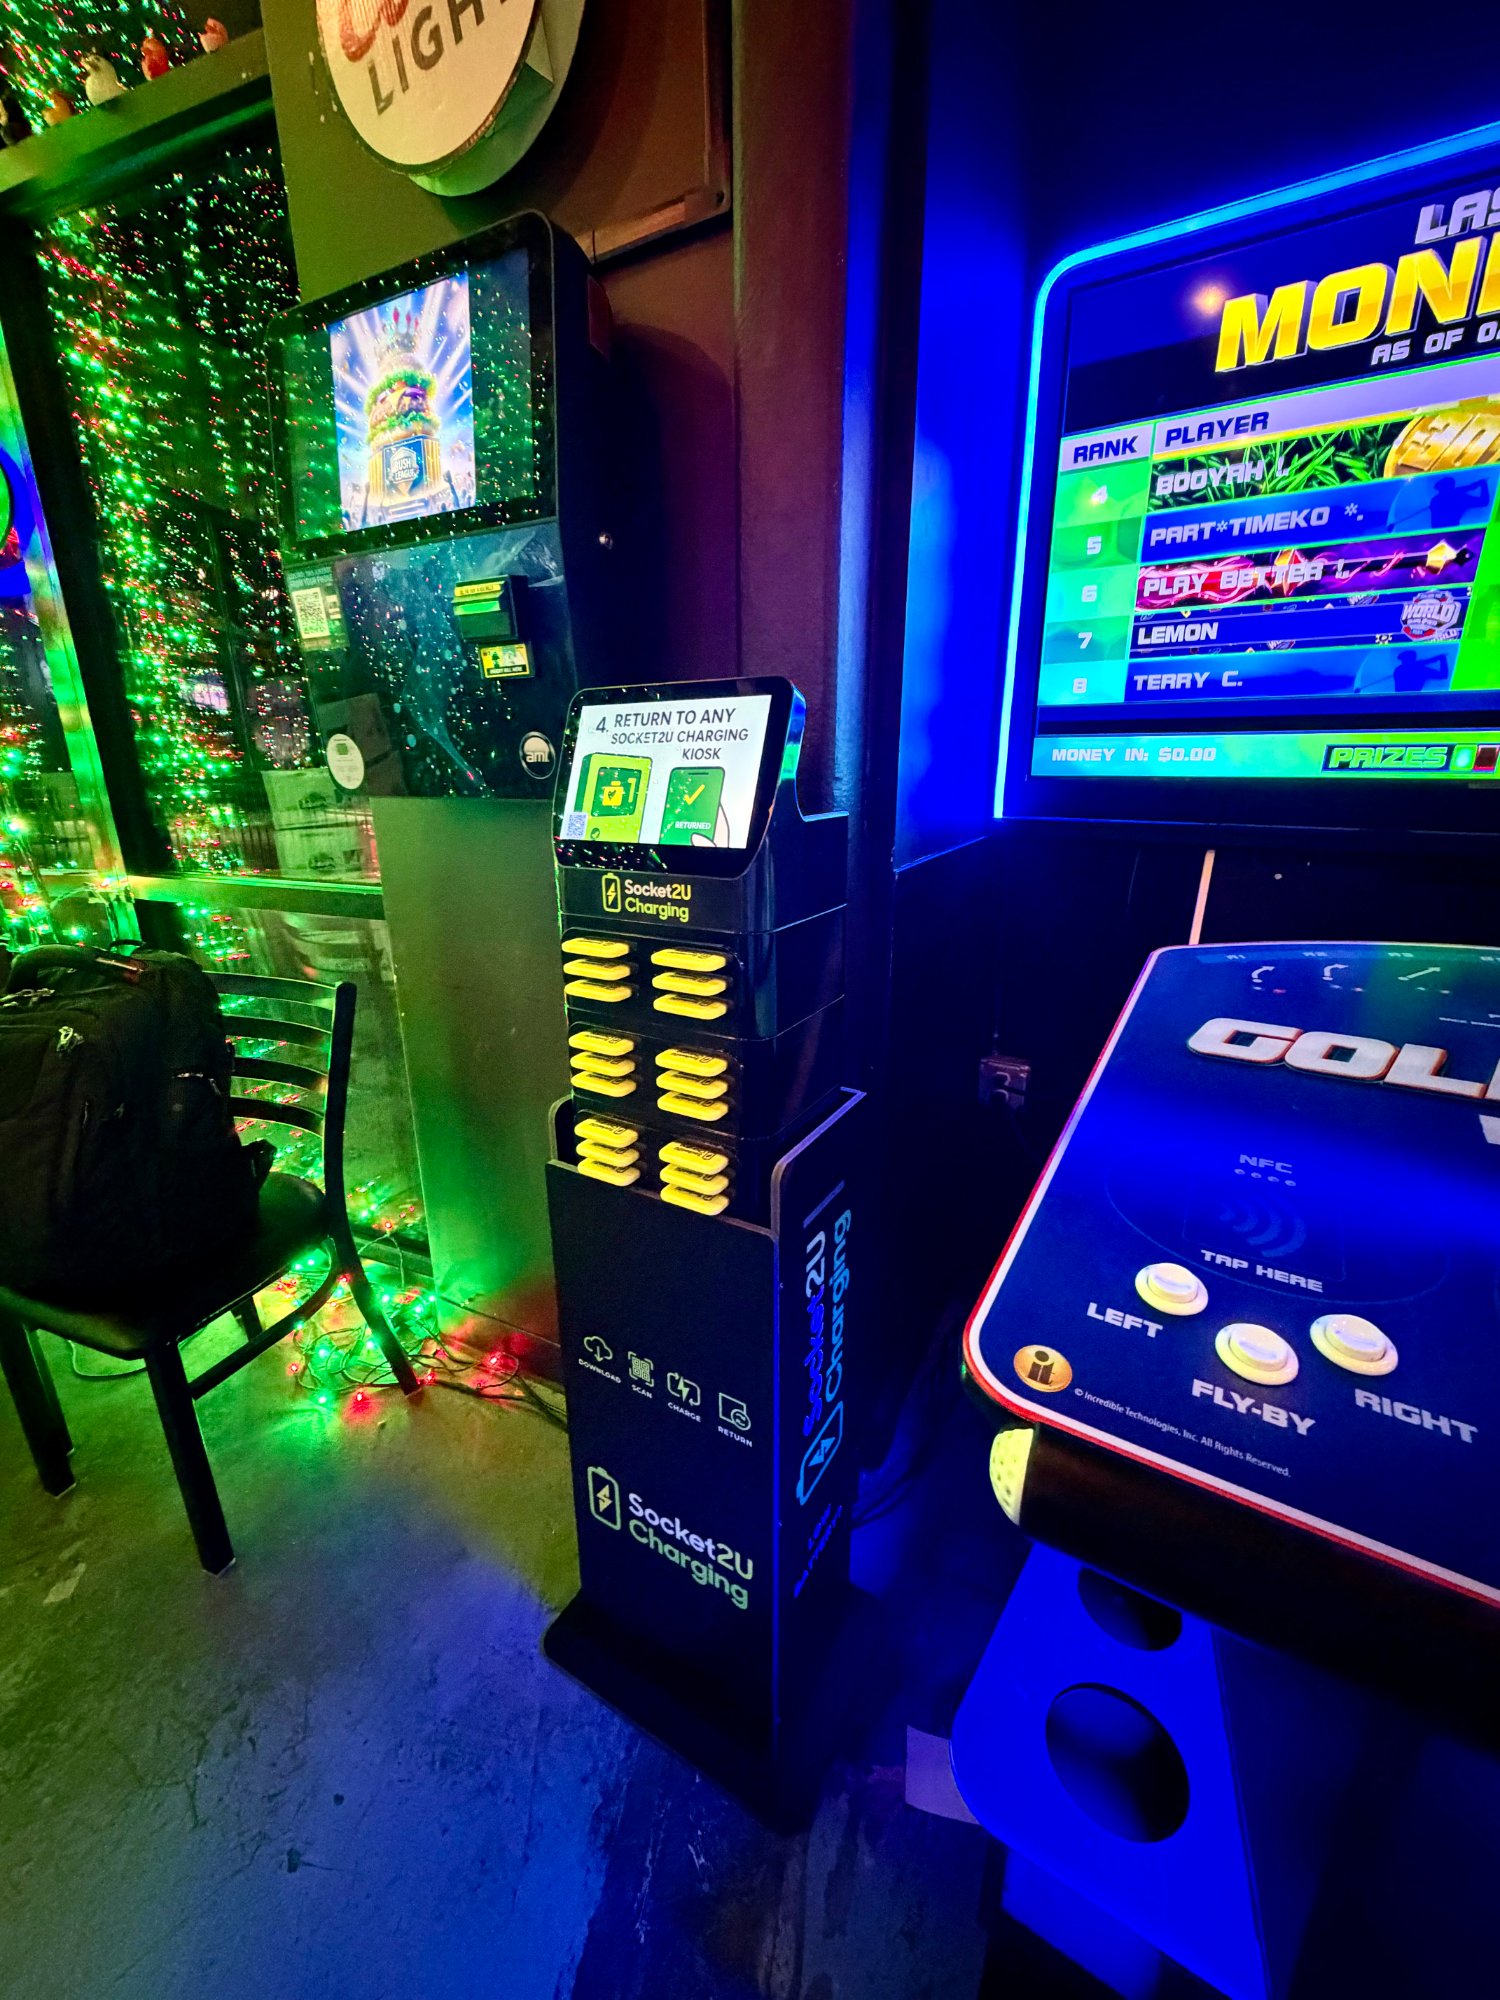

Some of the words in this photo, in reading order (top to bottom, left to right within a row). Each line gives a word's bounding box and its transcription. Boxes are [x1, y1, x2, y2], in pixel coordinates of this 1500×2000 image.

[367, 0, 510, 115] LIGH
[1215, 231, 1500, 373] MON
[1370, 339, 1411, 366] AS
[1424, 328, 1464, 354] OF
[1073, 435, 1139, 464] RANK
[1165, 411, 1270, 447] PLAYER
[1091, 486, 1108, 505] 4
[1155, 460, 1265, 496] BOOYAH
[1086, 536, 1102, 555] 5
[1082, 585, 1097, 603] 6
[1143, 571, 1208, 598] PLAY
[1219, 561, 1324, 590] BETTER
[1078, 631, 1094, 650] 7
[1137, 622, 1218, 646] LEMON
[1402, 600, 1456, 622] WORLD
[1073, 678, 1087, 694] 8
[1133, 672, 1210, 691] TERRY
[1221, 670, 1243, 688] C.
[596, 717, 609, 734] 4.
[614, 710, 672, 728] RETURN
[676, 710, 697, 725] TO
[699, 708, 736, 724] ANY
[611, 731, 674, 745] SOCKET2U
[677, 729, 749, 743] CHARGING
[682, 748, 721, 760] KIOSK
[1052, 748, 1115, 762] MONEY
[1125, 748, 1149, 762] IN:
[1158, 747, 1217, 763] $0.00
[1329, 747, 1448, 768] PRIZES
[674, 822, 711, 831] RETURNED
[624, 879, 692, 901] Socket2U
[625, 900, 690, 923] Charging
[1187, 1017, 1500, 1101] GOL
[1239, 1154, 1293, 1174] NFC
[1201, 1250, 1248, 1269] TAP
[1256, 1265, 1323, 1293] HERE
[825, 1209, 852, 1402] Charging
[1086, 1302, 1164, 1338] LEFT
[578, 1358, 622, 1384] DOWNLOAD
[631, 1384, 653, 1399] SCAN
[667, 1402, 701, 1423] CHARGE
[1191, 1379, 1317, 1436] FLY-BY
[1354, 1388, 1479, 1444] RIGHT
[717, 1425, 752, 1447] RETURN
[1084, 1391, 1124, 1413] Incredible
[1183, 1429, 1199, 1443] Inc.
[1200, 1436, 1213, 1448] All
[1214, 1440, 1244, 1460] Rights
[1245, 1452, 1292, 1478] Reserved.
[628, 1492, 753, 1580] Socket2U
[628, 1519, 749, 1610] Charging
